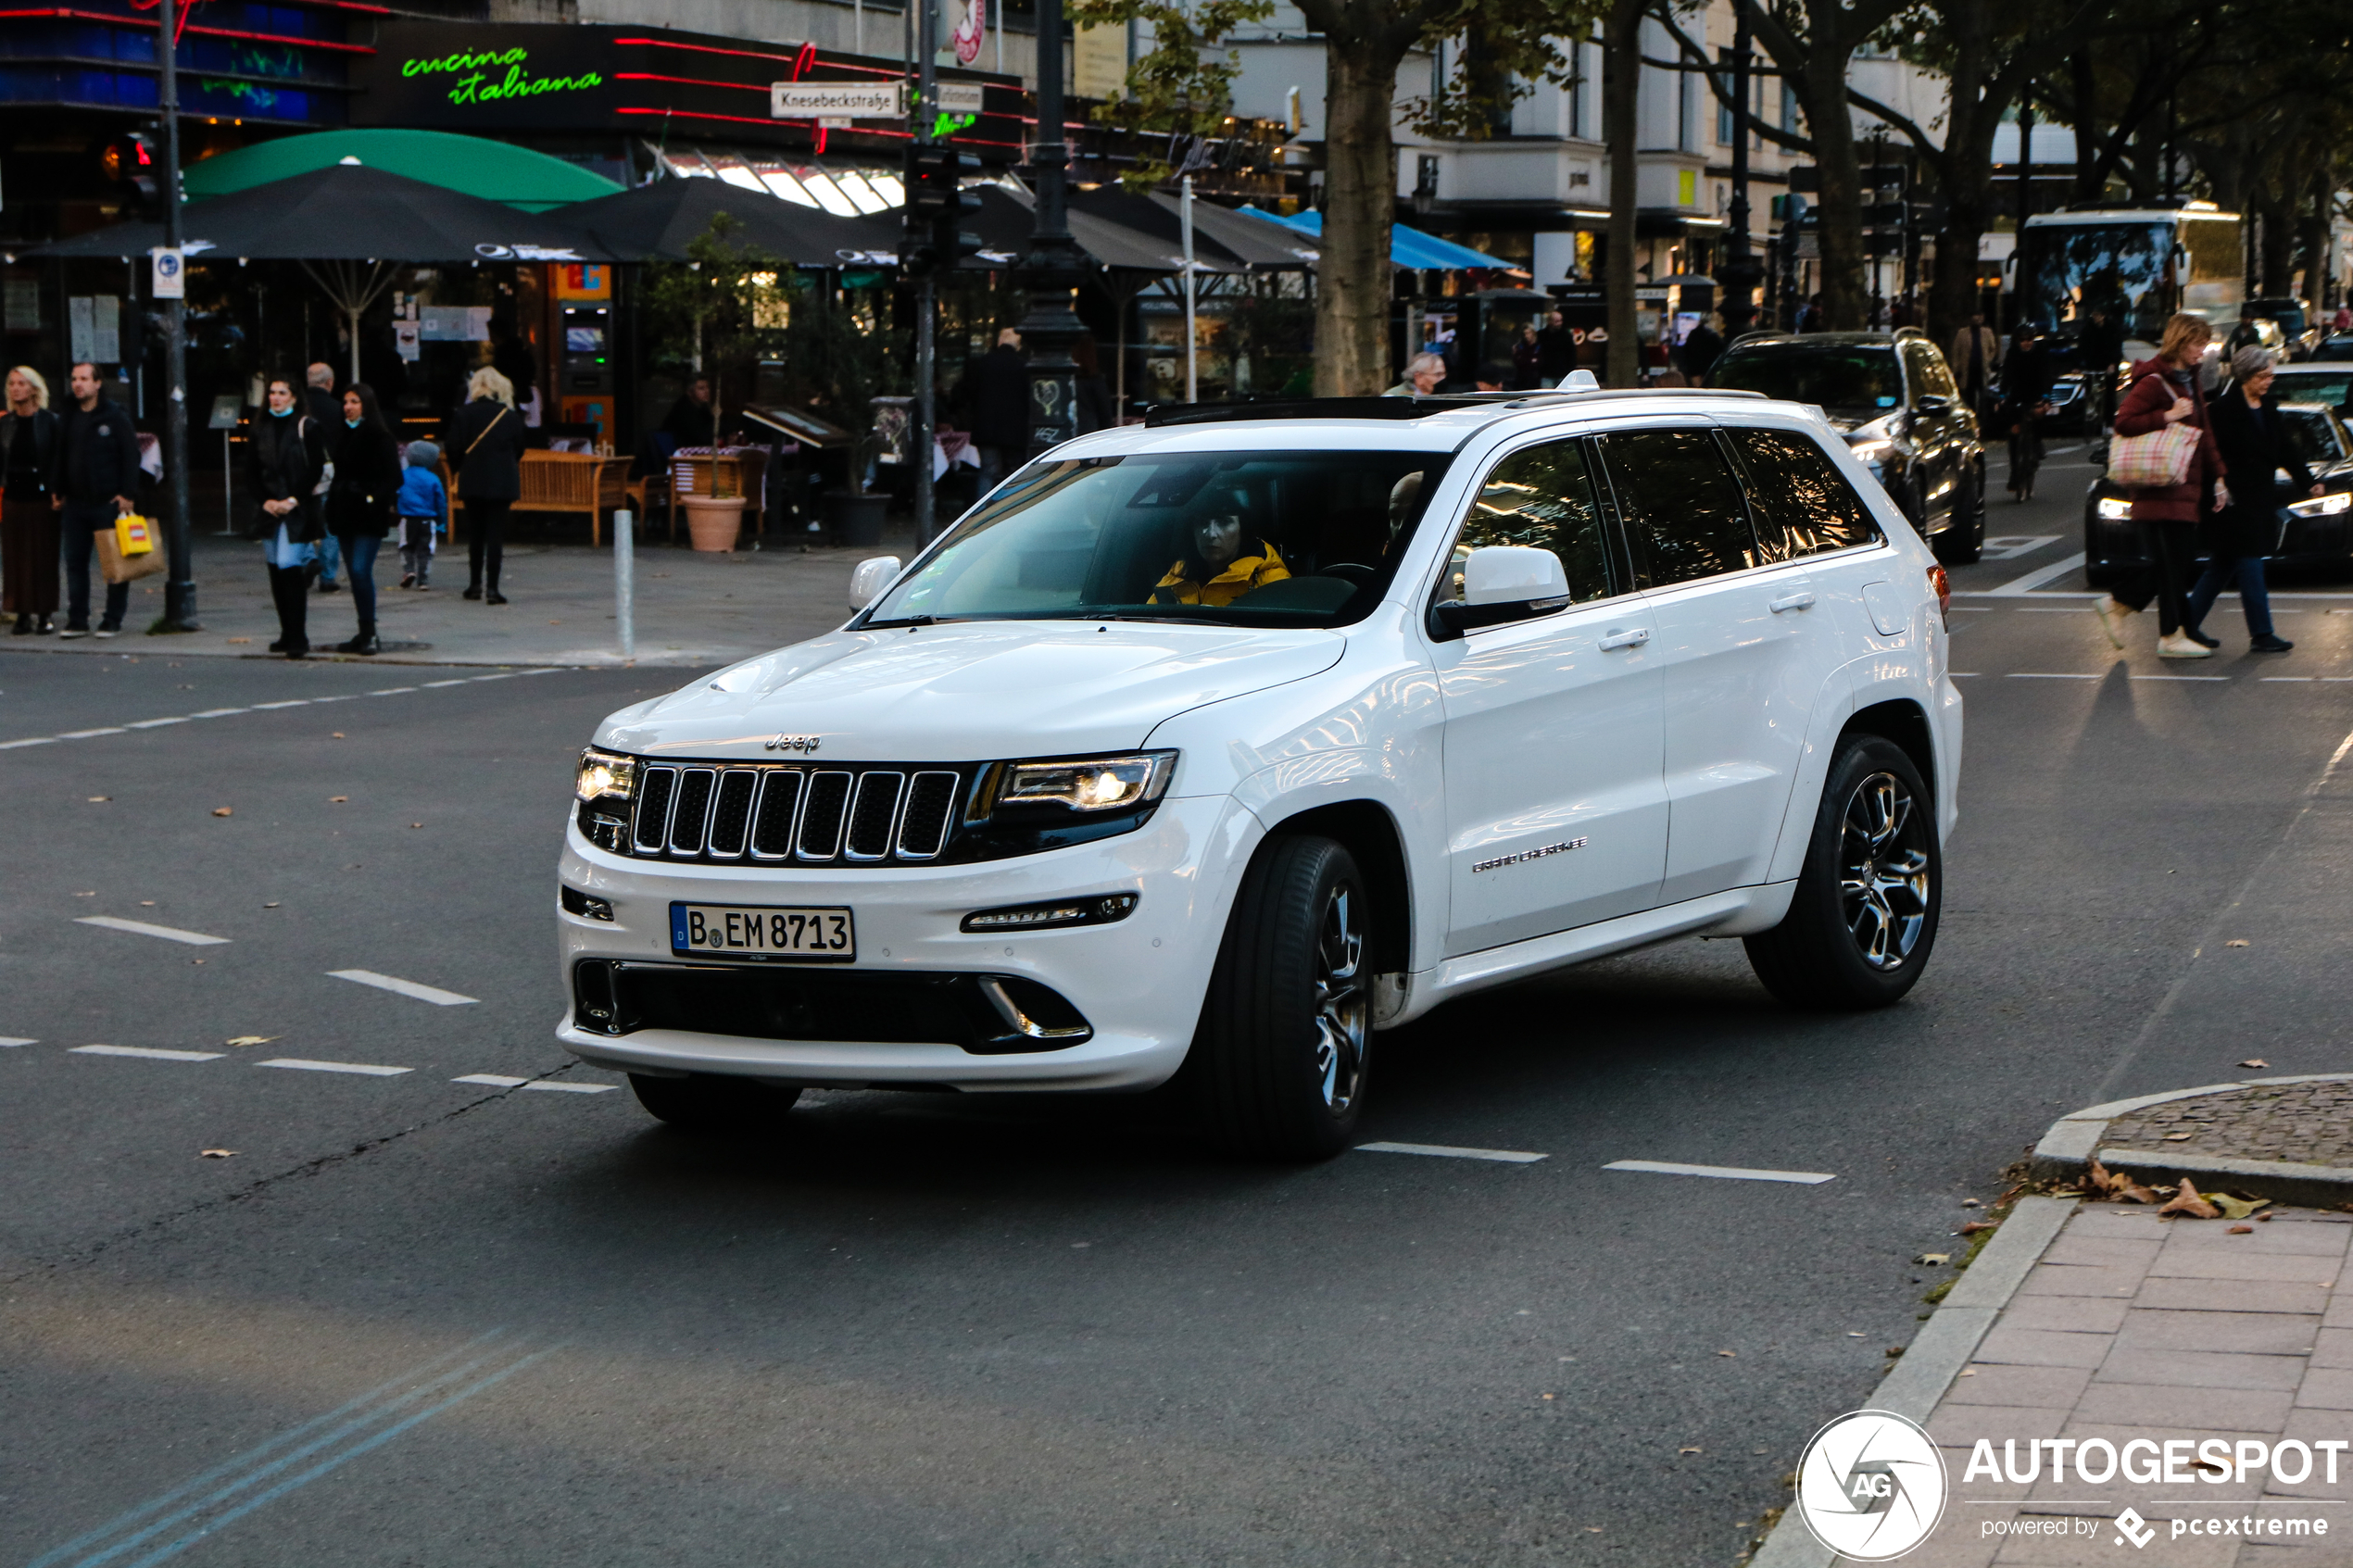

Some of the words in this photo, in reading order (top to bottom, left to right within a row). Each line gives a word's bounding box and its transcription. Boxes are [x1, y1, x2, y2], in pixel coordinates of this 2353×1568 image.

[402, 46, 528, 77] cucina
[447, 64, 602, 105] italiana
[781, 92, 891, 111] Knesebeckstraße
[764, 731, 823, 755] Jeep
[1472, 853, 1517, 873] GRAND
[1519, 836, 1589, 862] CHEROKEE
[689, 910, 707, 945] B
[725, 912, 763, 947] EM
[771, 914, 848, 949] 8713
